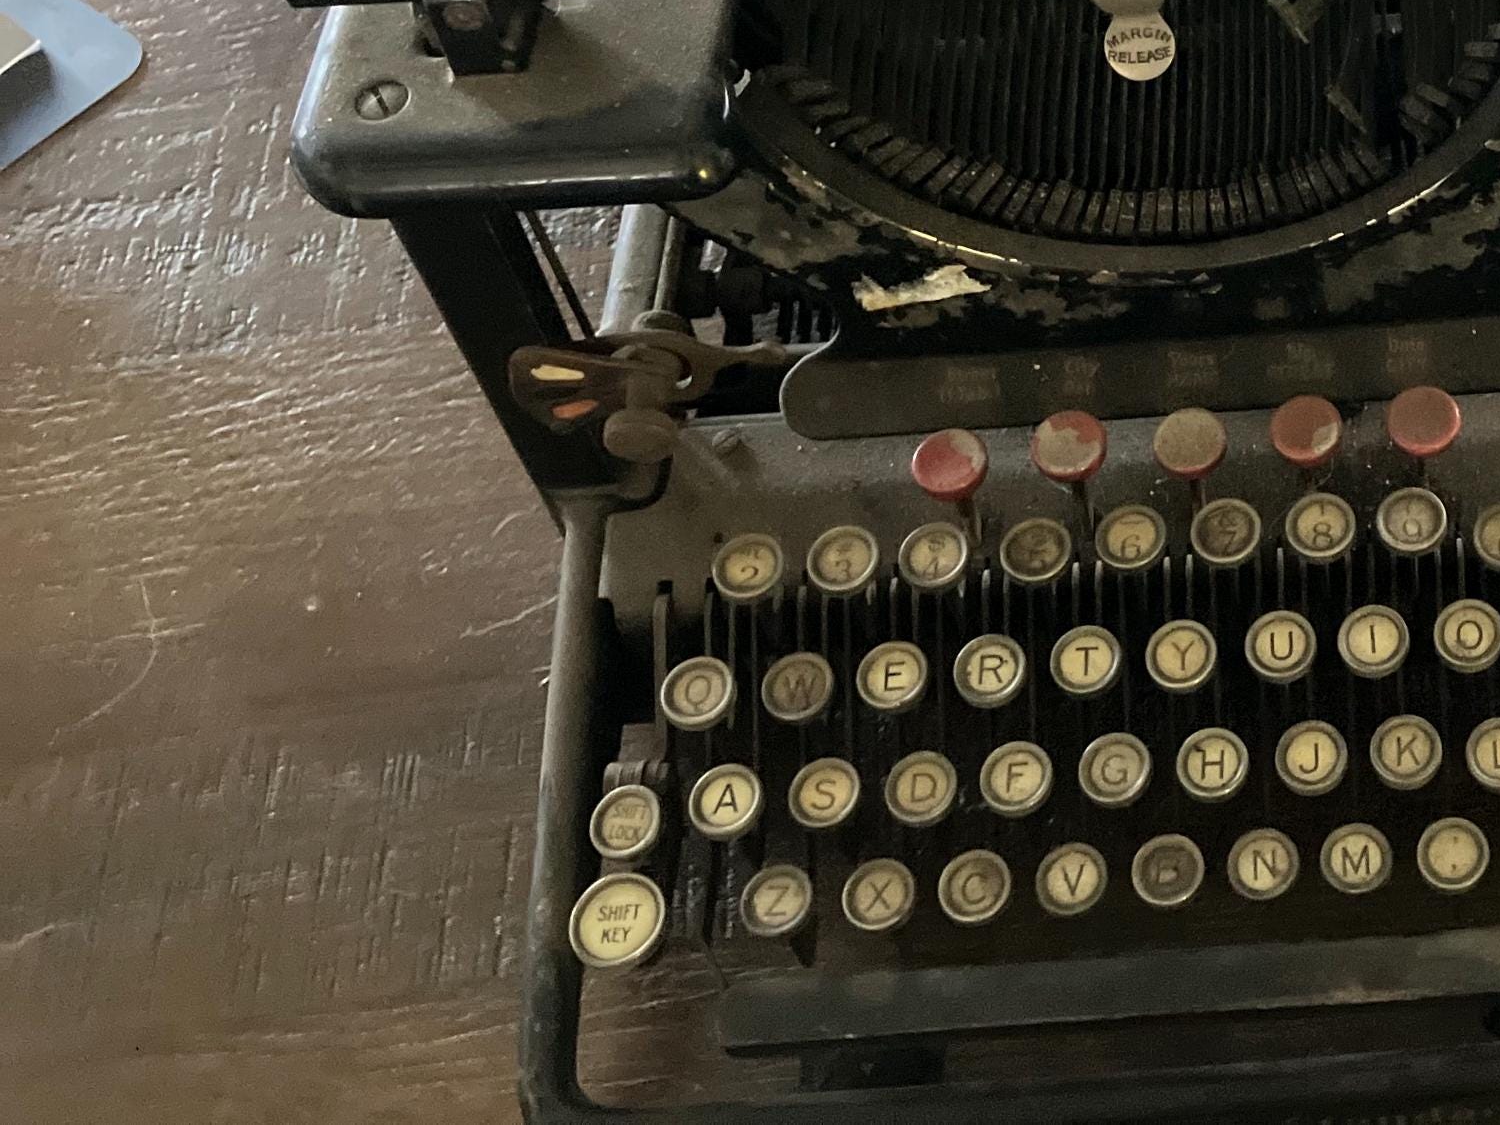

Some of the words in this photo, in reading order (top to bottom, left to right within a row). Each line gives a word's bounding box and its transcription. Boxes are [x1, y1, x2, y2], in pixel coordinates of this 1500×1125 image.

[1106, 27, 1172, 48] MARGIN
[1108, 46, 1173, 64] RELEASE
[1120, 534, 1142, 559] 6
[1218, 530, 1238, 556] 7
[1312, 522, 1333, 549] 8
[835, 558, 852, 582] 3
[1270, 632, 1293, 660] U
[1456, 620, 1483, 650] O
[978, 654, 1008, 686] R
[1075, 646, 1099, 676] T
[1172, 640, 1196, 670] Y
[784, 673, 813, 707] W
[884, 661, 906, 691] E
[684, 675, 711, 711] Q
[1200, 748, 1224, 780] H
[1299, 743, 1319, 774] J
[1395, 736, 1421, 767] K
[1005, 761, 1028, 793] F
[1102, 753, 1128, 785] G
[713, 783, 739, 815] A
[810, 779, 838, 810] S
[910, 773, 937, 802] D
[608, 826, 642, 842] LOCK
[1253, 849, 1277, 881] N
[1341, 844, 1371, 876] M
[961, 872, 986, 905] C
[1062, 863, 1087, 897] V
[765, 884, 789, 916] Z
[864, 880, 891, 912] X
[597, 903, 642, 922] SHIFT
[601, 927, 631, 944] KEY
